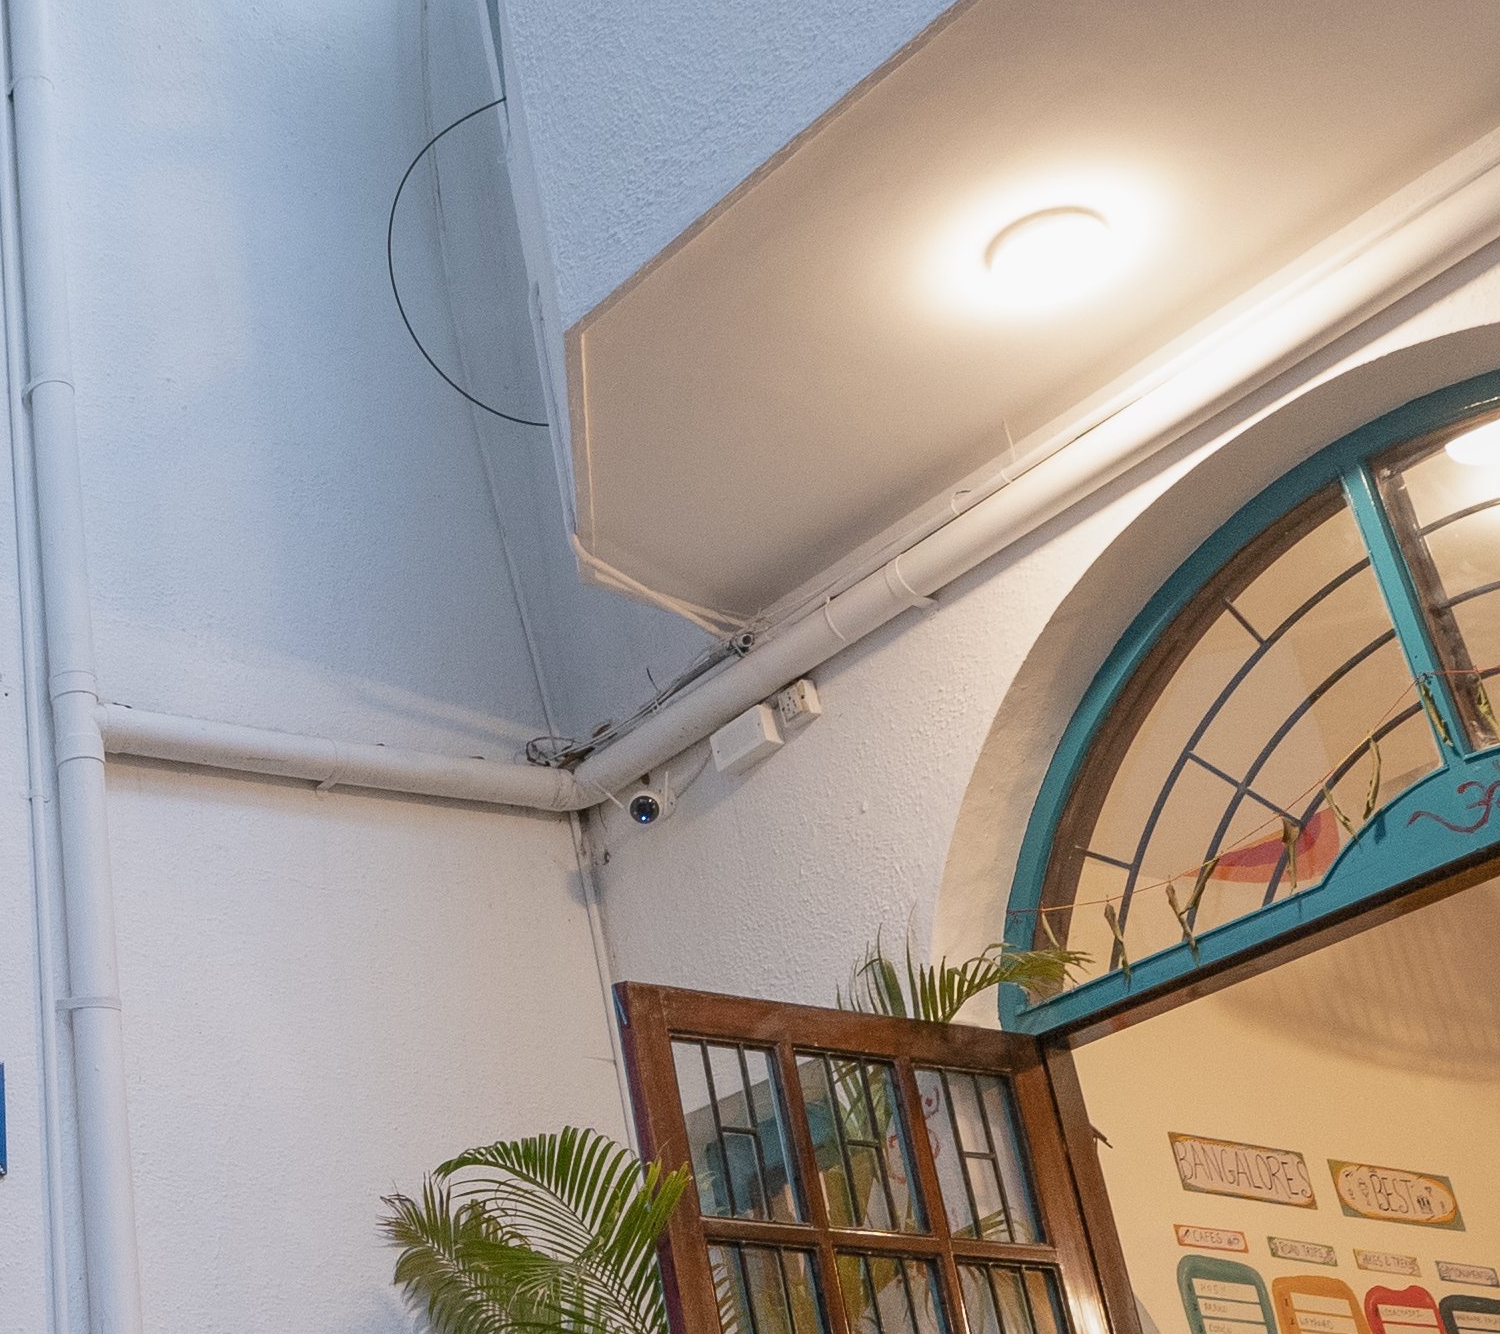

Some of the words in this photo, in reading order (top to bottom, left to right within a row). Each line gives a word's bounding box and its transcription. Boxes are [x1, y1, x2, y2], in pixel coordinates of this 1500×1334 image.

[1174, 1141, 1314, 1200] BANGALORES
[1369, 1173, 1417, 1215] BEST
[1192, 1228, 1223, 1245] CAFES
